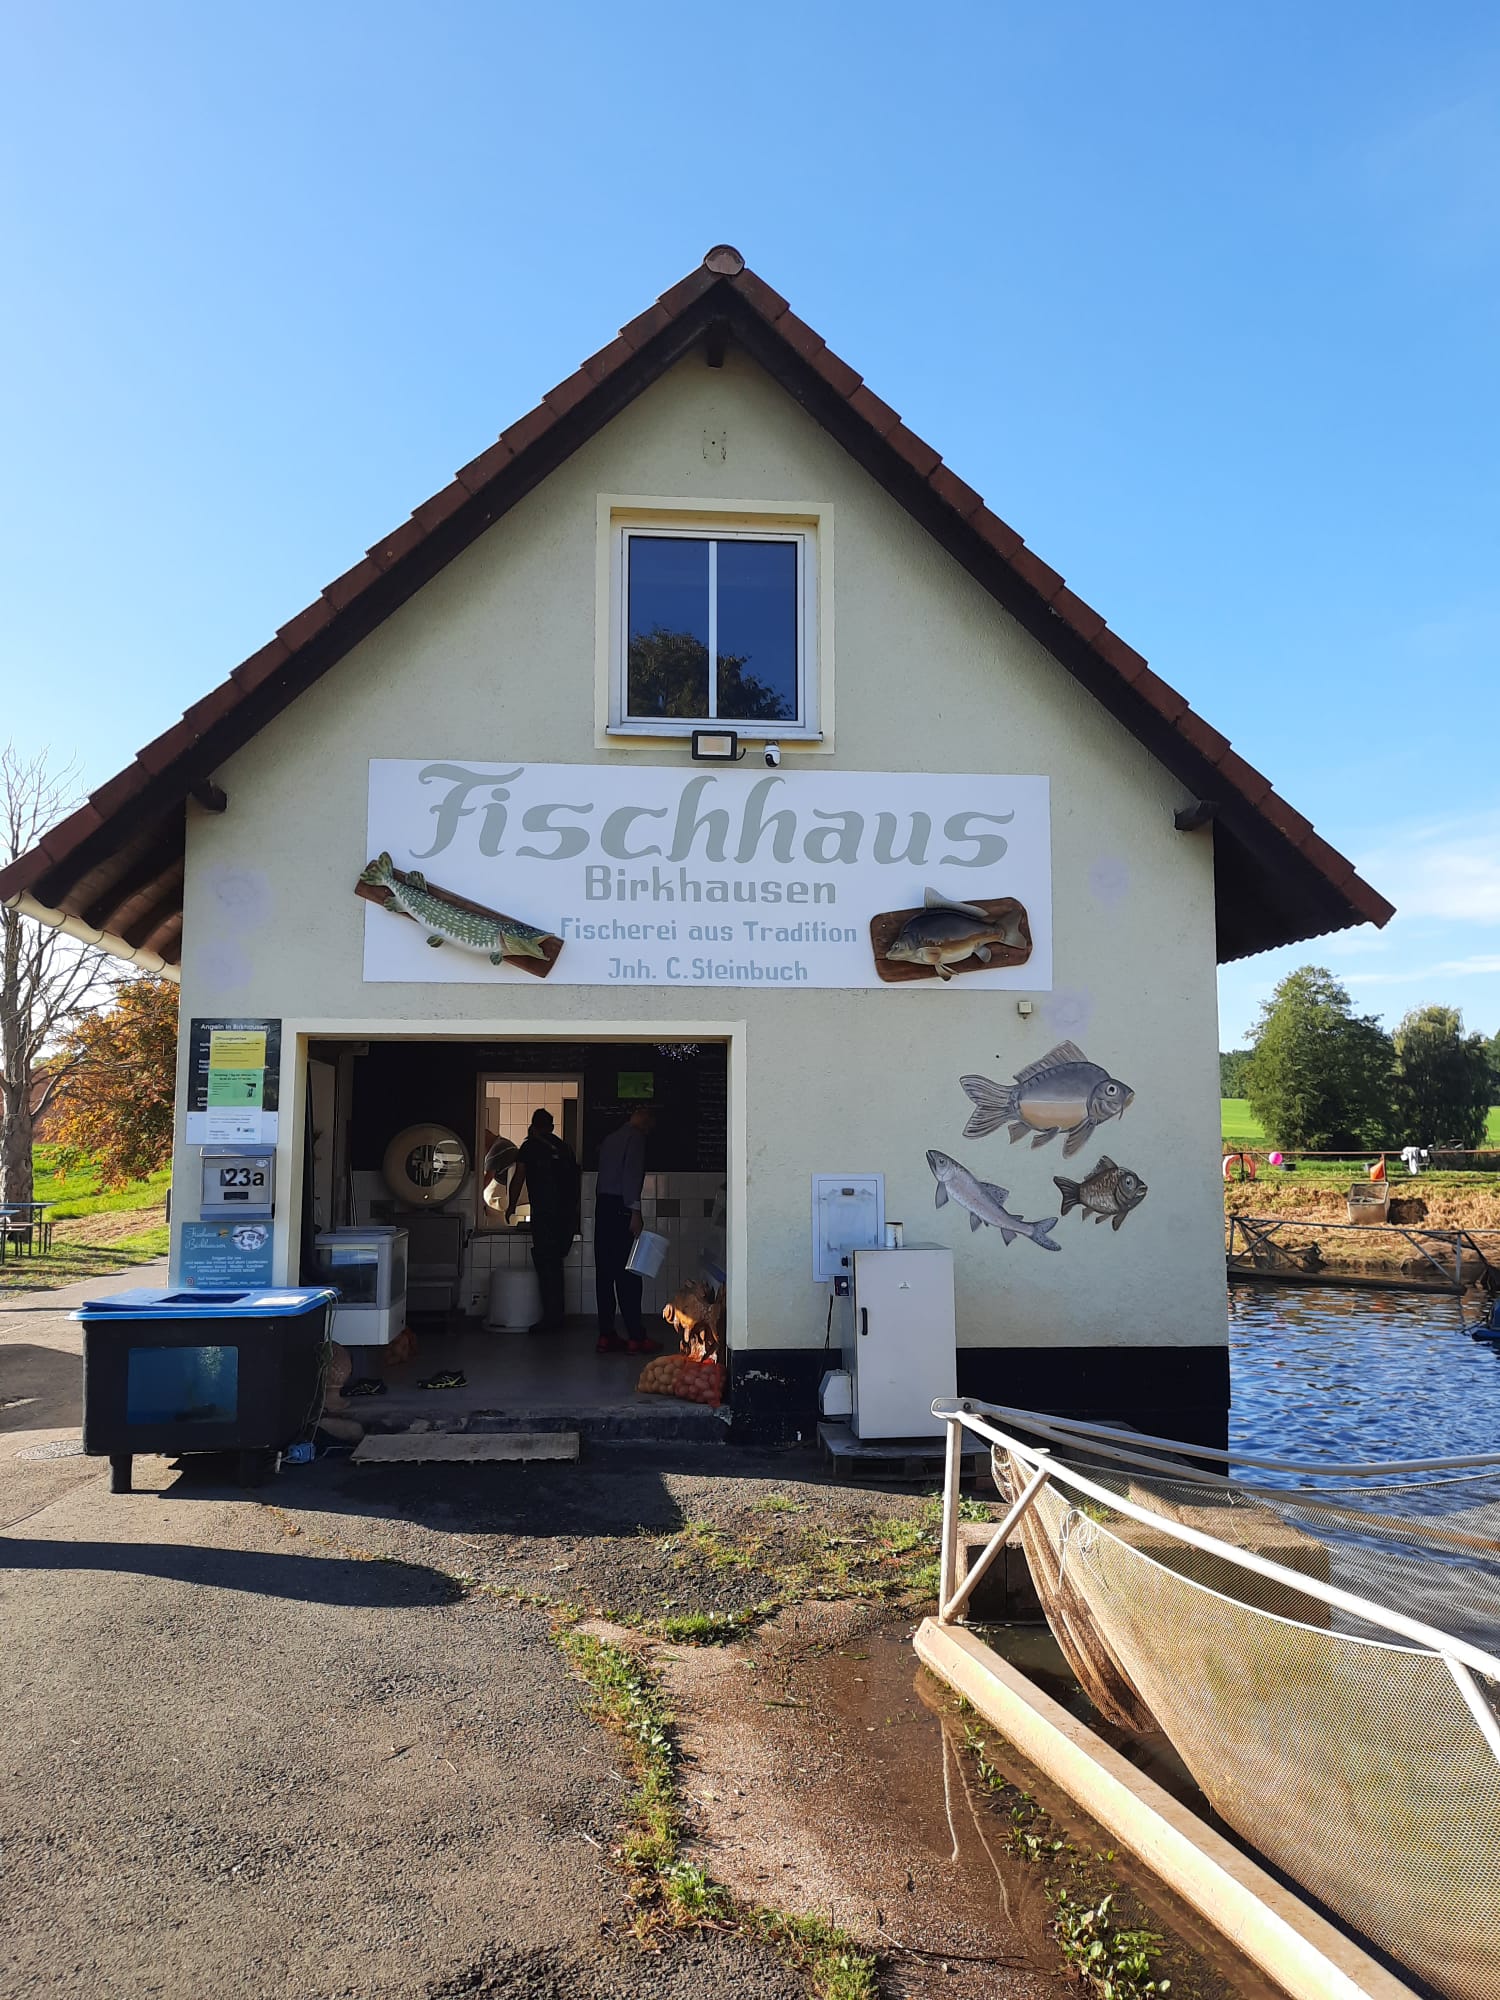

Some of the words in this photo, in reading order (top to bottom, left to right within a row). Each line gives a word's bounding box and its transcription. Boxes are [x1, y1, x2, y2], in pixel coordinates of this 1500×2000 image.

[409, 764, 1015, 866] Fischhaus
[585, 864, 836, 904] Birkhausen
[560, 917, 677, 941] Fischerei
[688, 922, 733, 942] aus
[742, 920, 857, 943] Tradition
[224, 1168, 265, 1187] 23a
